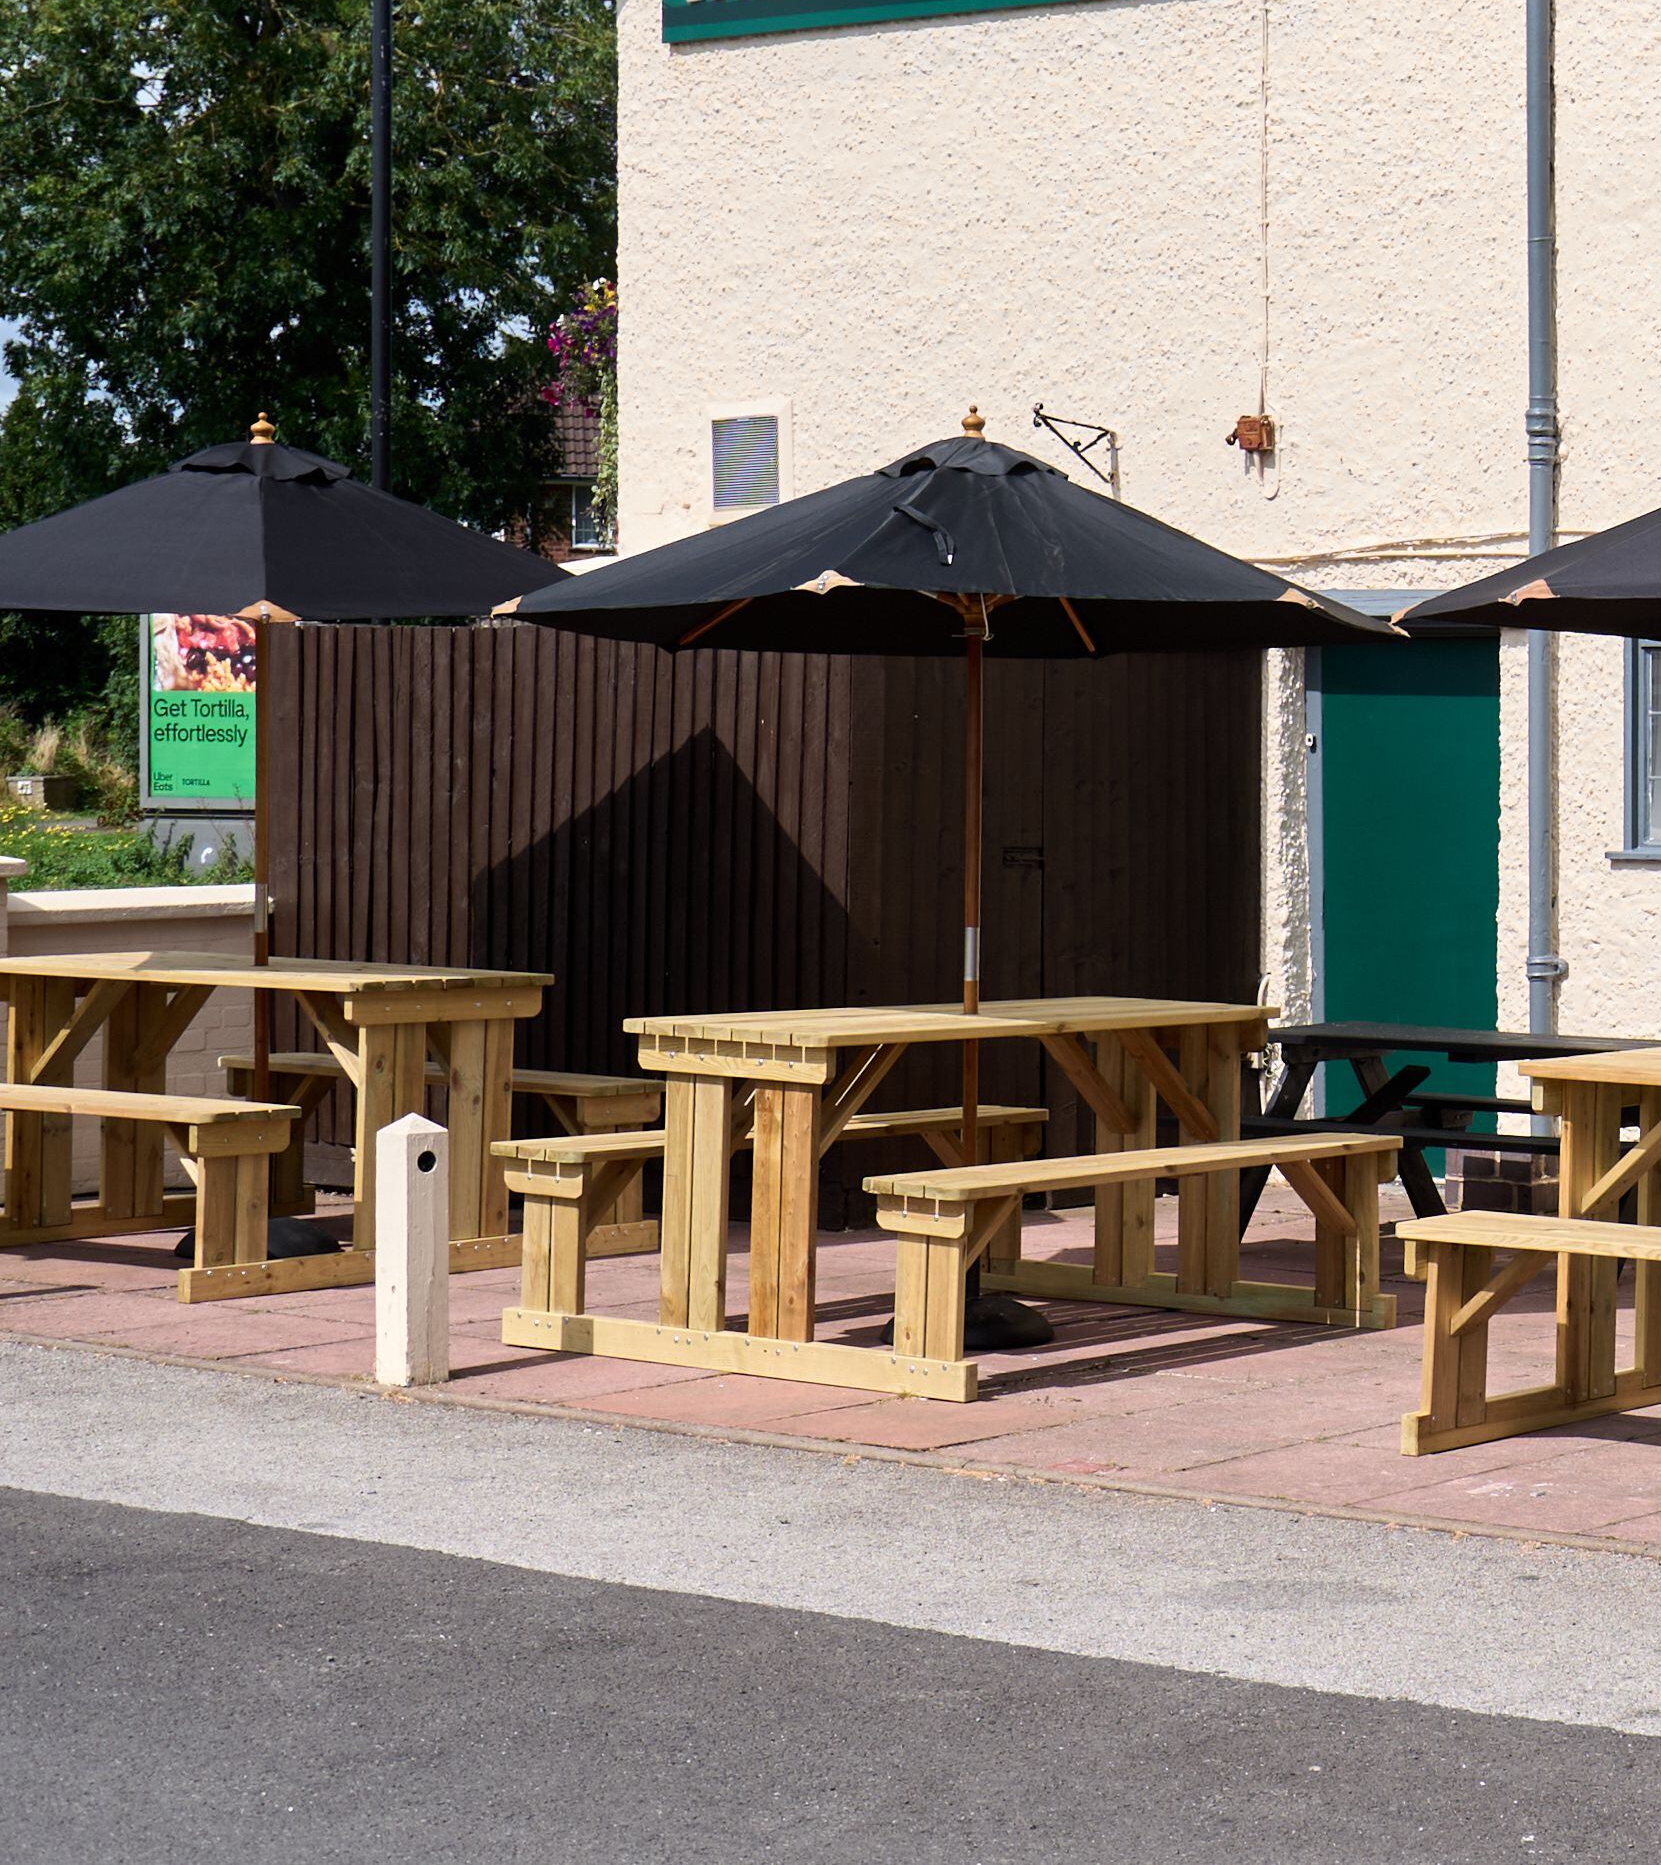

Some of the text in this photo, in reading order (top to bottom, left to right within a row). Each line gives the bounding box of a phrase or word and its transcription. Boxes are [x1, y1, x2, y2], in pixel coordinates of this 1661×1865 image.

[154, 698, 249, 721] Get Tortilla,
[154, 722, 248, 747] effortlessly
[153, 772, 173, 781] Uber
[153, 782, 173, 791] Eats
[182, 778, 211, 786] TORTILLA
